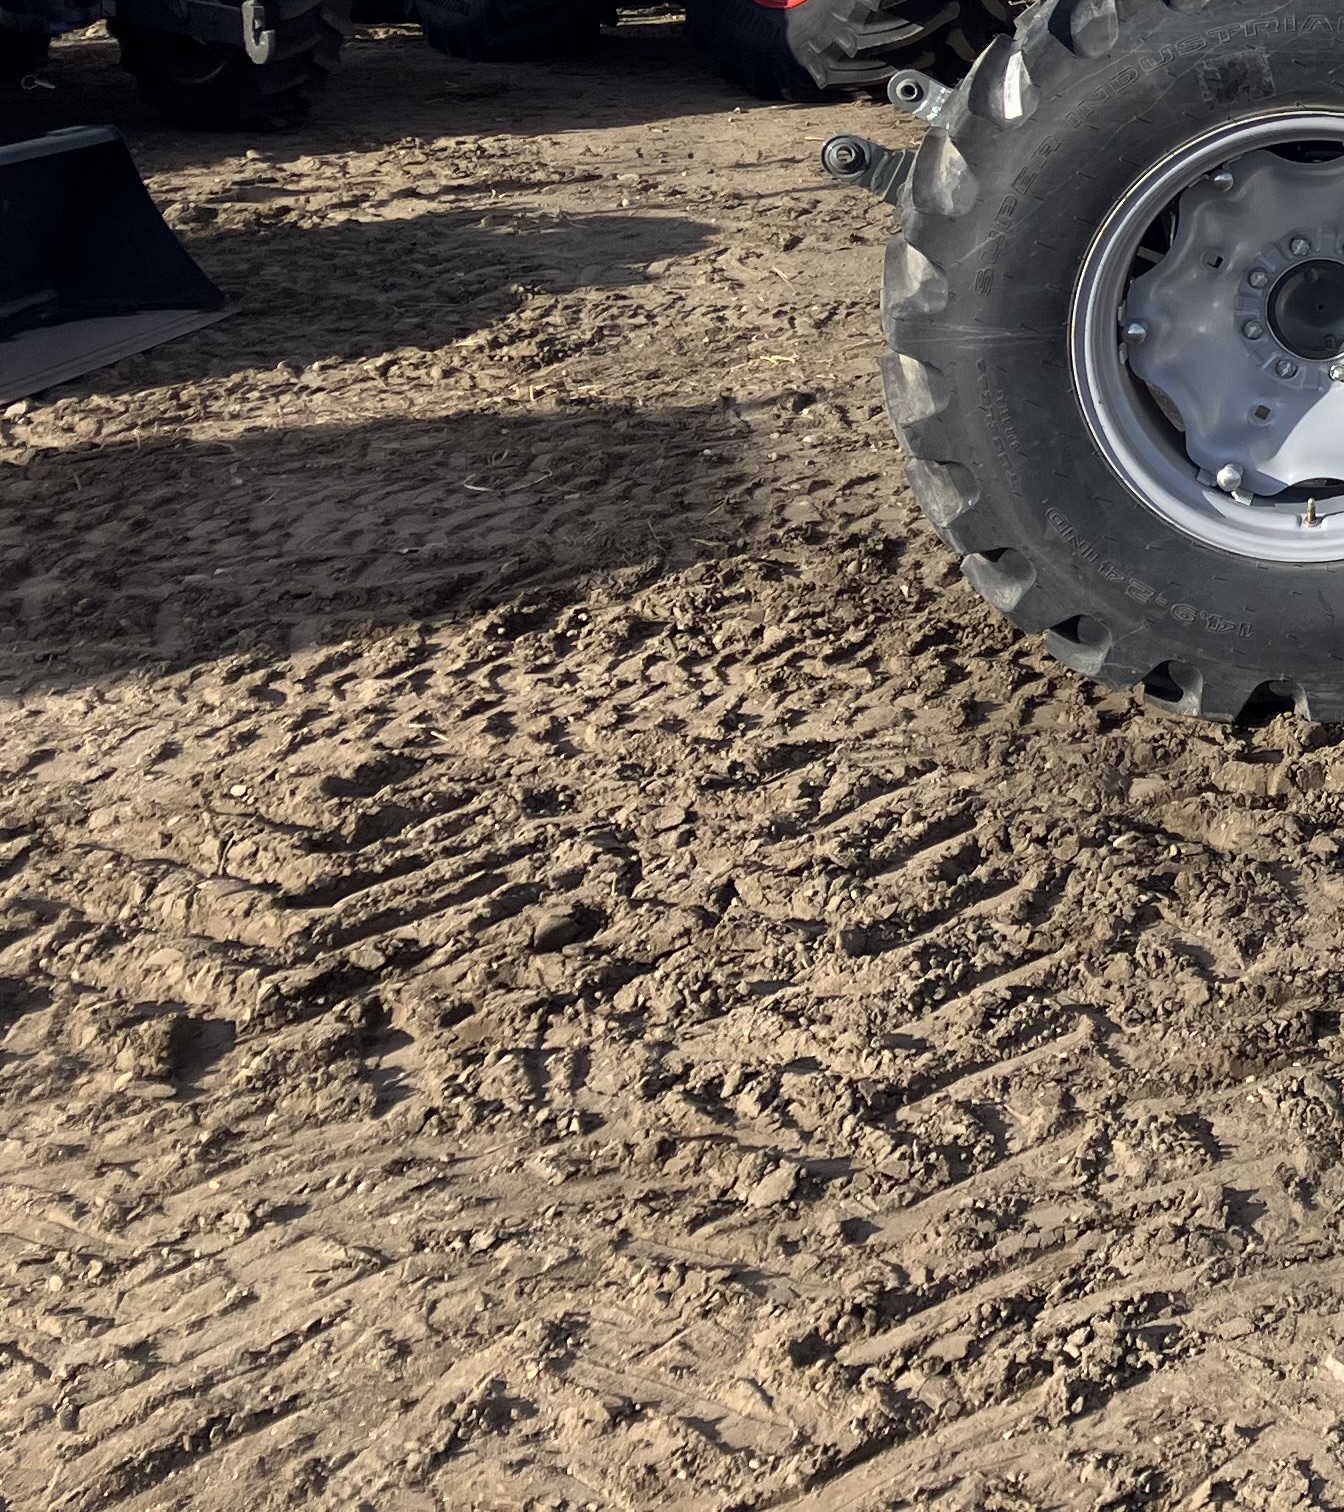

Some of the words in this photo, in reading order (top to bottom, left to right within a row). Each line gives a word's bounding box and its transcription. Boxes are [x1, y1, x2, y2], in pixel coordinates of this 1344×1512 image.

[974, 133, 1063, 299] SUPER
[1045, 506, 1100, 565] IND
[1097, 559, 1256, 642] 14.9-24
